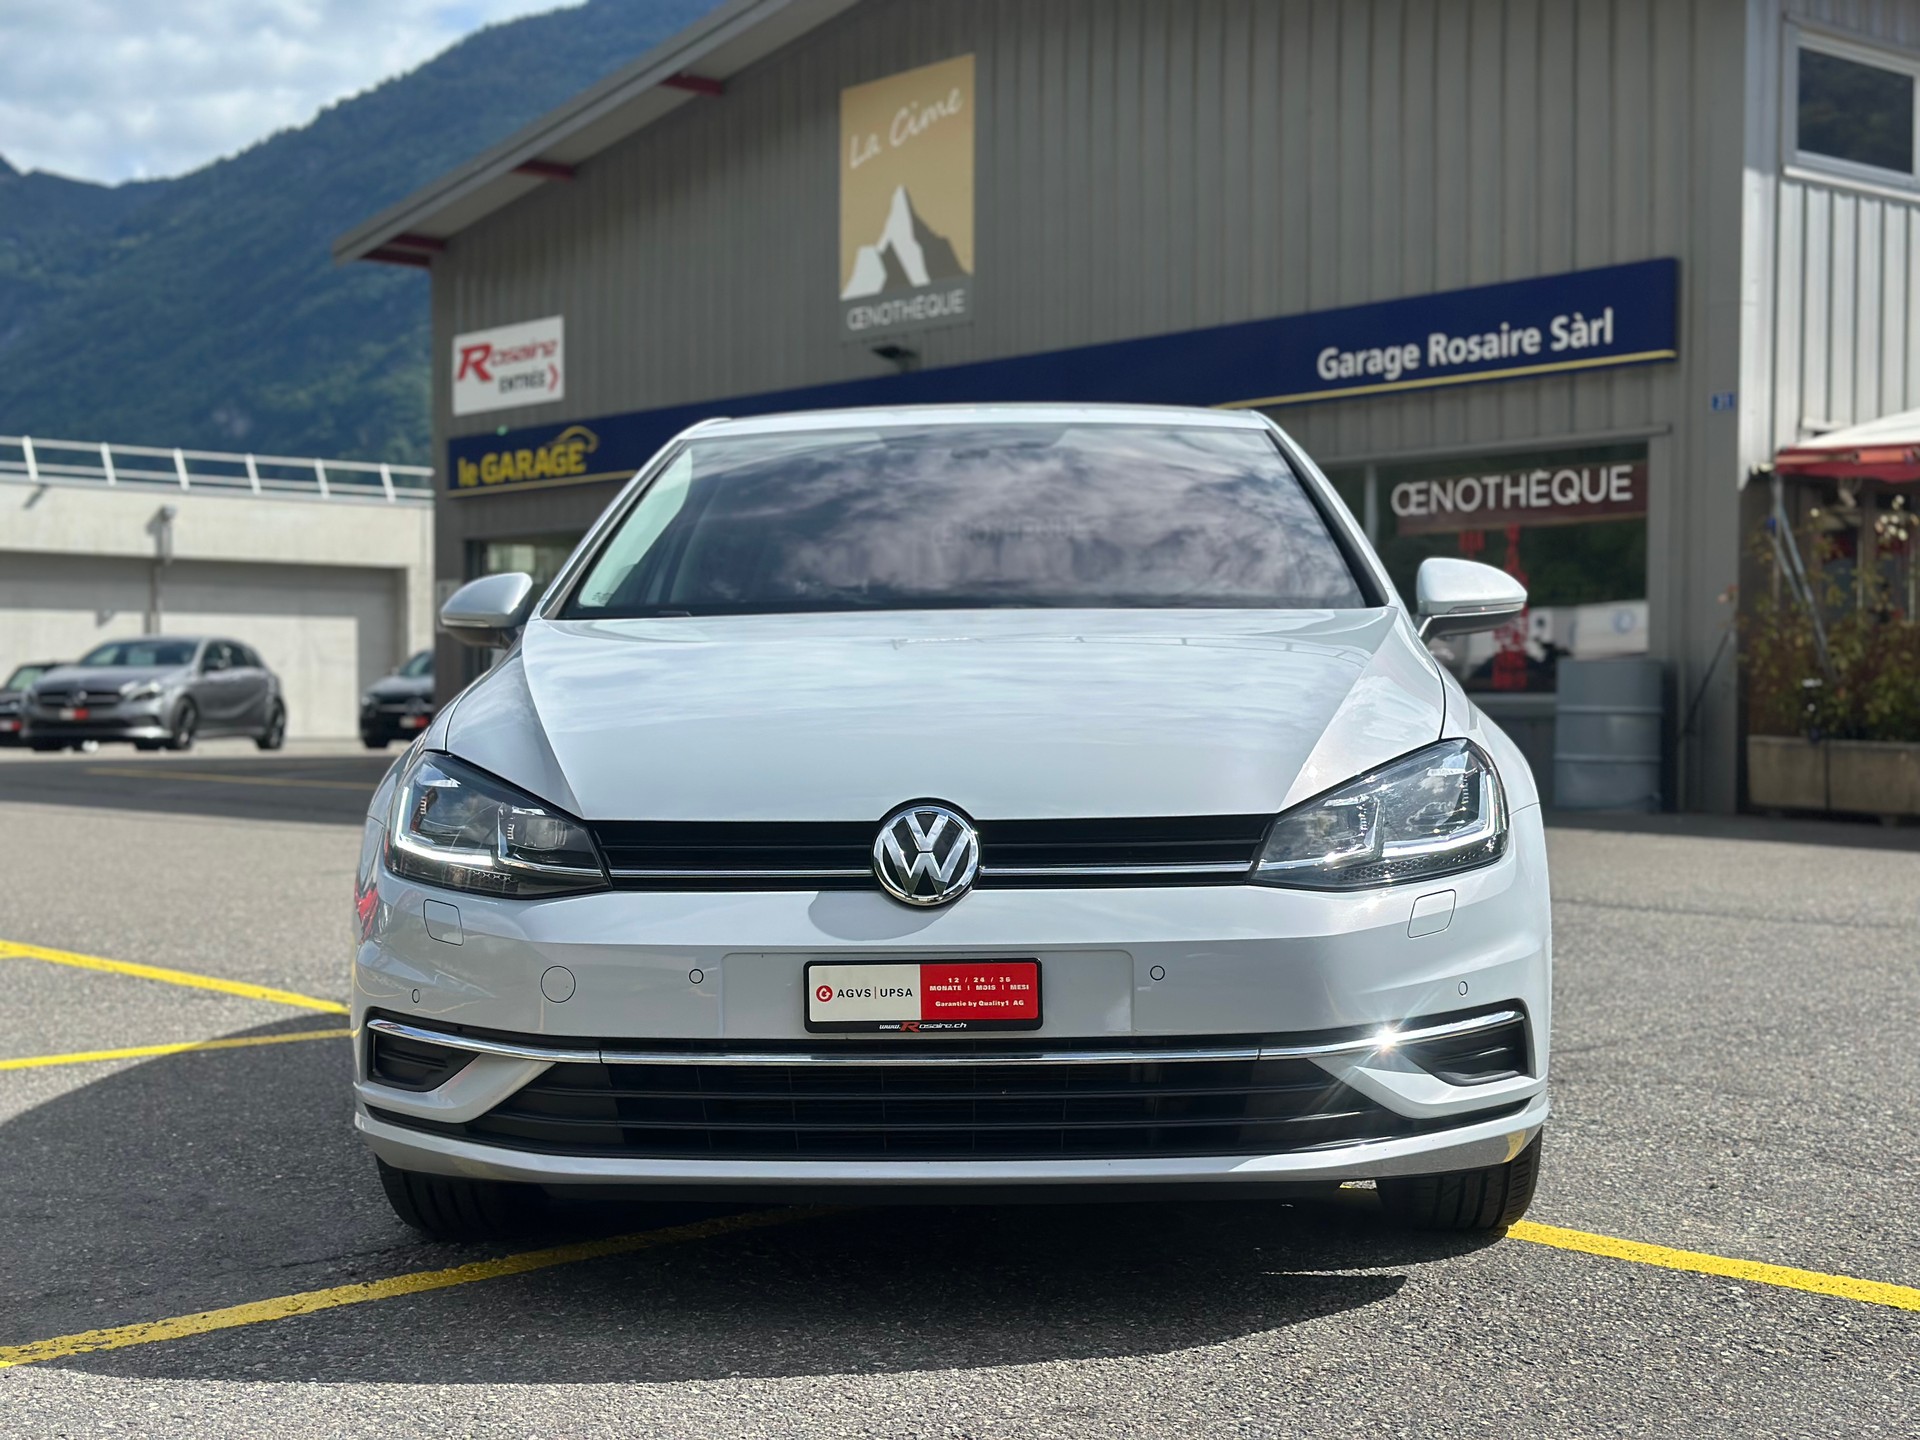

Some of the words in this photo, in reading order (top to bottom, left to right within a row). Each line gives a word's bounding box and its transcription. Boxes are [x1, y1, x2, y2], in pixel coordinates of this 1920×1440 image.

[1317, 343, 1421, 381] Garage
[1427, 322, 1542, 367] Rosaire
[1550, 307, 1614, 351] Sàrl
[480, 441, 587, 485] GARAGE
[881, 811, 971, 898] VW
[836, 988, 872, 998] AGVS
[880, 988, 913, 998] UPSA
